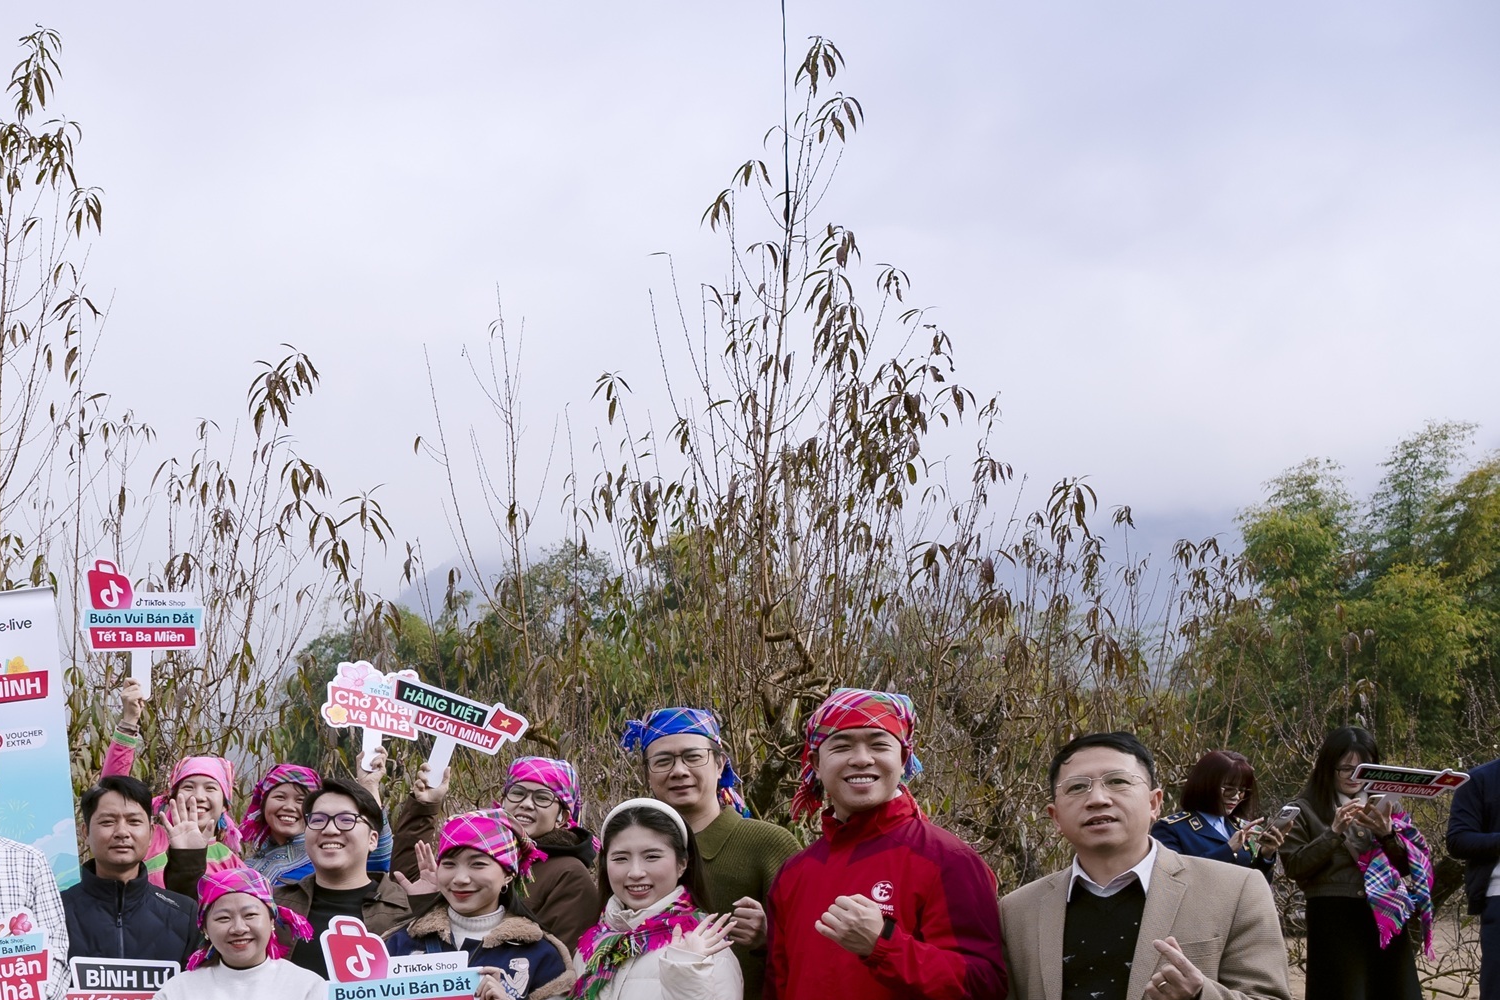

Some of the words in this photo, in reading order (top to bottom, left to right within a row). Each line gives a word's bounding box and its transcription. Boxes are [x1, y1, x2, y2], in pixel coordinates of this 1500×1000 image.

[144, 599, 166, 607] TikTok
[168, 599, 186, 607] Shop
[90, 613, 121, 624] Buôn
[124, 613, 144, 624] Vui
[146, 612, 170, 624] Bán
[173, 611, 194, 624] Đắt
[97, 630, 116, 642] Tết
[119, 631, 133, 642] Ta
[135, 631, 152, 642] Ba
[154, 630, 185, 642] Miền
[334, 690, 372, 708] Chở
[403, 687, 448, 711] HÀNG
[450, 702, 483, 723] VIỆT
[349, 708, 368, 722] Về
[370, 711, 410, 732] Nhà
[5, 729, 43, 740] VOUCHER
[418, 713, 457, 735] VƯƠN
[458, 726, 494, 748] MÌNH
[6, 739, 32, 747] EXTRA
[1364, 770, 1401, 781] HÀNG
[1403, 773, 1431, 783] VIỆT
[1373, 783, 1404, 792] VƯƠN
[1405, 786, 1437, 796] MÌNH
[2, 946, 13, 955] Ba
[14, 944, 36, 953] Miền
[404, 963, 433, 973] TikTok
[435, 962, 458, 971] Shop
[86, 966, 138, 988] BÌNH
[143, 968, 171, 988] LƯ
[335, 986, 376, 1000] Buôn
[380, 983, 405, 997] Vui
[409, 980, 439, 995] Bán
[443, 976, 471, 992] Đắt
